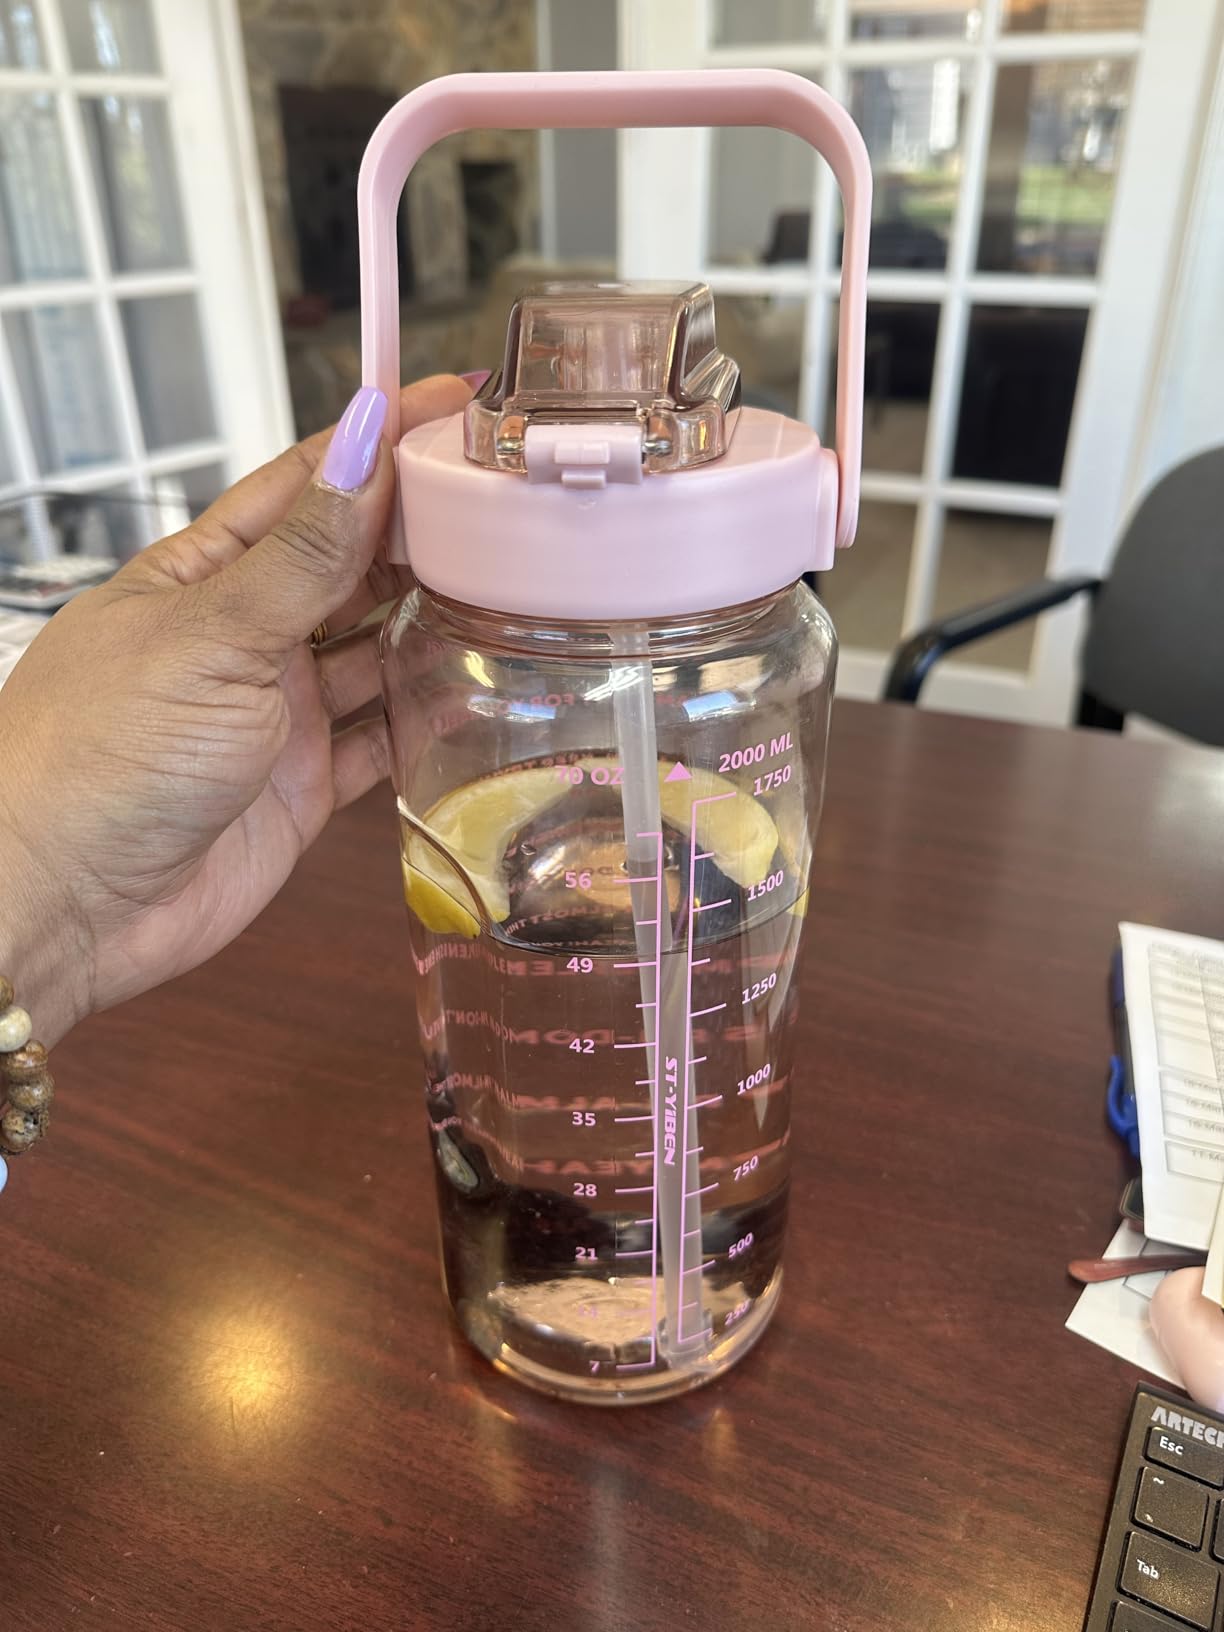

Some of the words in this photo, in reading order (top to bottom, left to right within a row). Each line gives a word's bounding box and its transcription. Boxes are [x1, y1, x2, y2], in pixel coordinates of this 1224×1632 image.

[718, 744, 765, 773] 2000
[769, 732, 794, 757] ML
[554, 766, 584, 785] 70
[590, 767, 625, 785] OZ
[752, 764, 792, 796] 1750
[565, 871, 592, 889] 56
[747, 869, 785, 901] 1500
[566, 957, 594, 973] 49
[741, 972, 777, 1005] 1250
[568, 1038, 595, 1054] 42
[736, 1063, 771, 1096] 1000
[572, 1111, 597, 1126] 35
[732, 1155, 759, 1182] 750
[573, 1182, 598, 1197] 28
[575, 1246, 598, 1261] 21
[728, 1232, 754, 1259] 500
[724, 1299, 750, 1326] 250
[588, 1360, 600, 1373] 7
[1159, 1435, 1184, 1456] Esc
[1136, 1558, 1160, 1580] Tab
